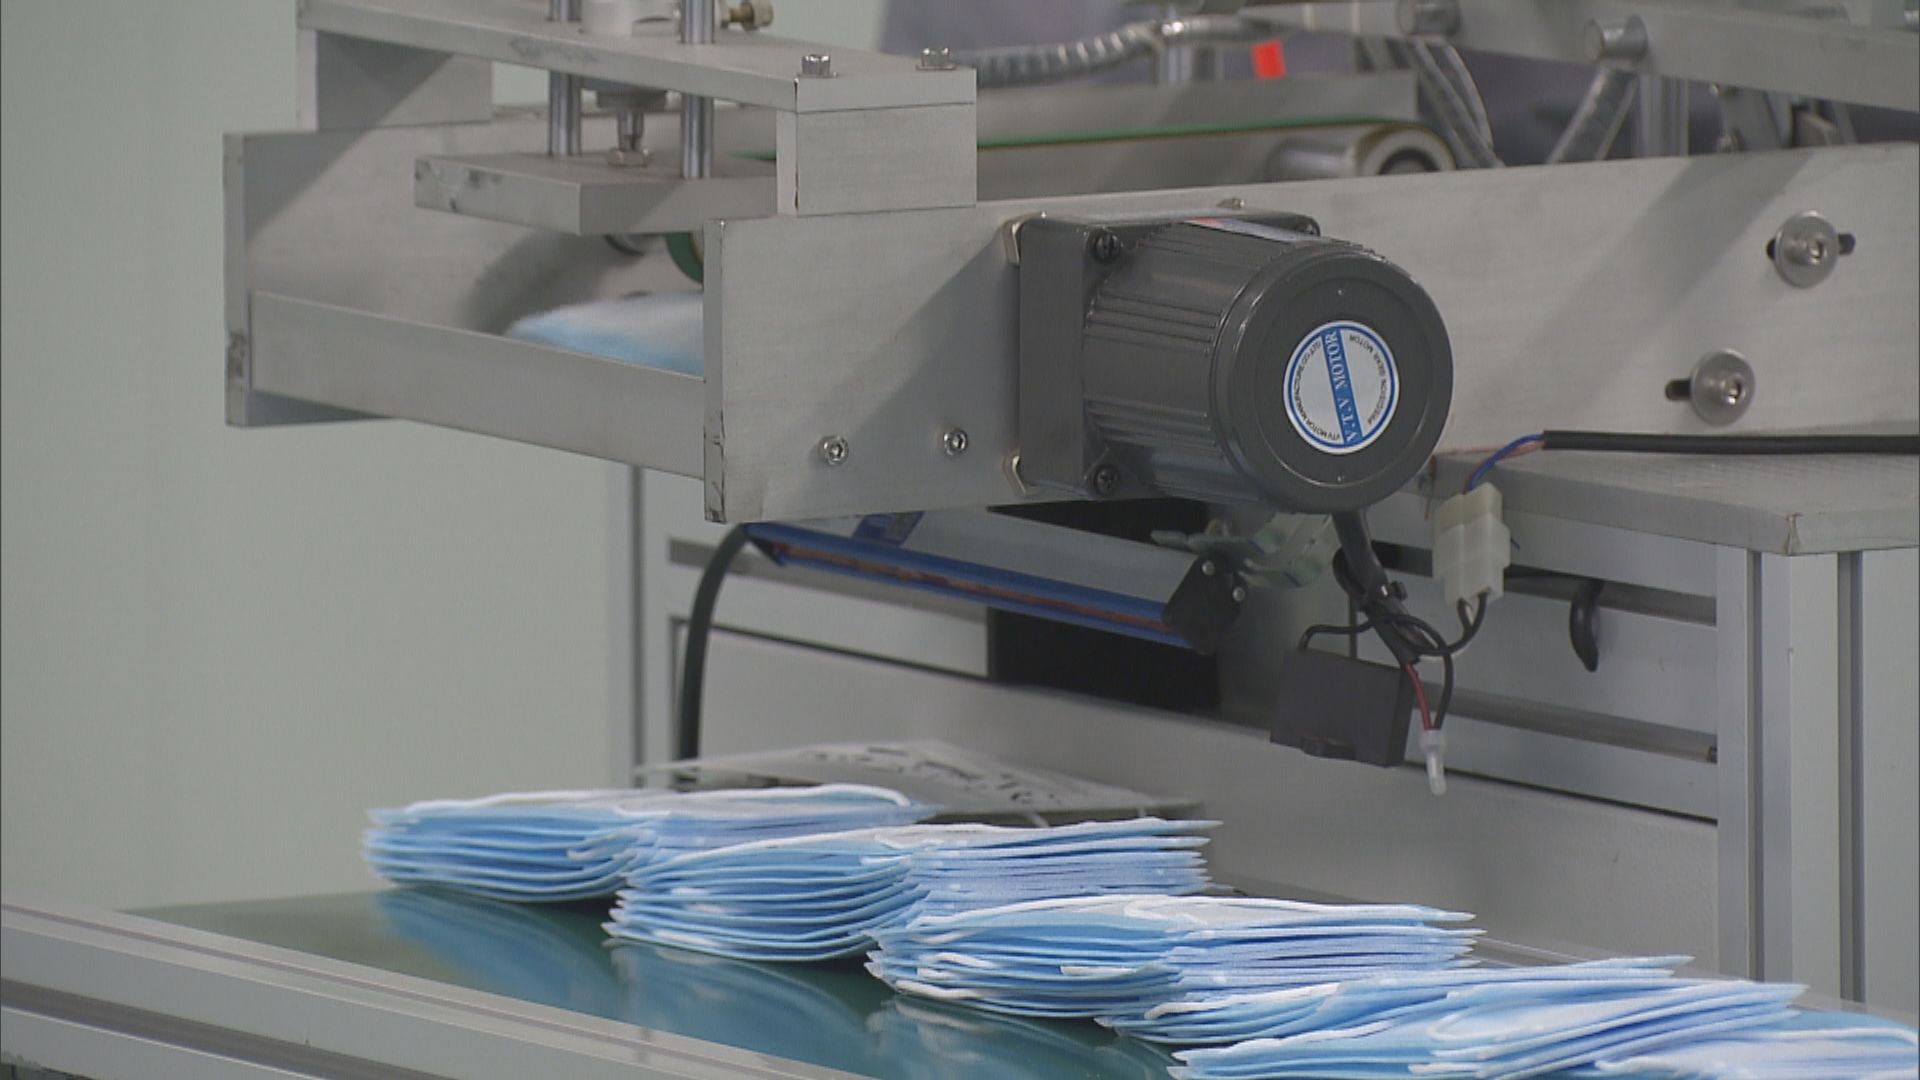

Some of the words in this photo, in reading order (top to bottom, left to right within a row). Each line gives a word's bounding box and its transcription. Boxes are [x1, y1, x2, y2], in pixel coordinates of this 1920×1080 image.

[1349, 334, 1374, 353] MOTOR
[1325, 331, 1348, 390] MOTOR
[1373, 353, 1386, 376] GEAR
[1368, 379, 1387, 424] PRECISION
[1305, 419, 1326, 438] MOTOR
[1327, 430, 1340, 441] VTV
